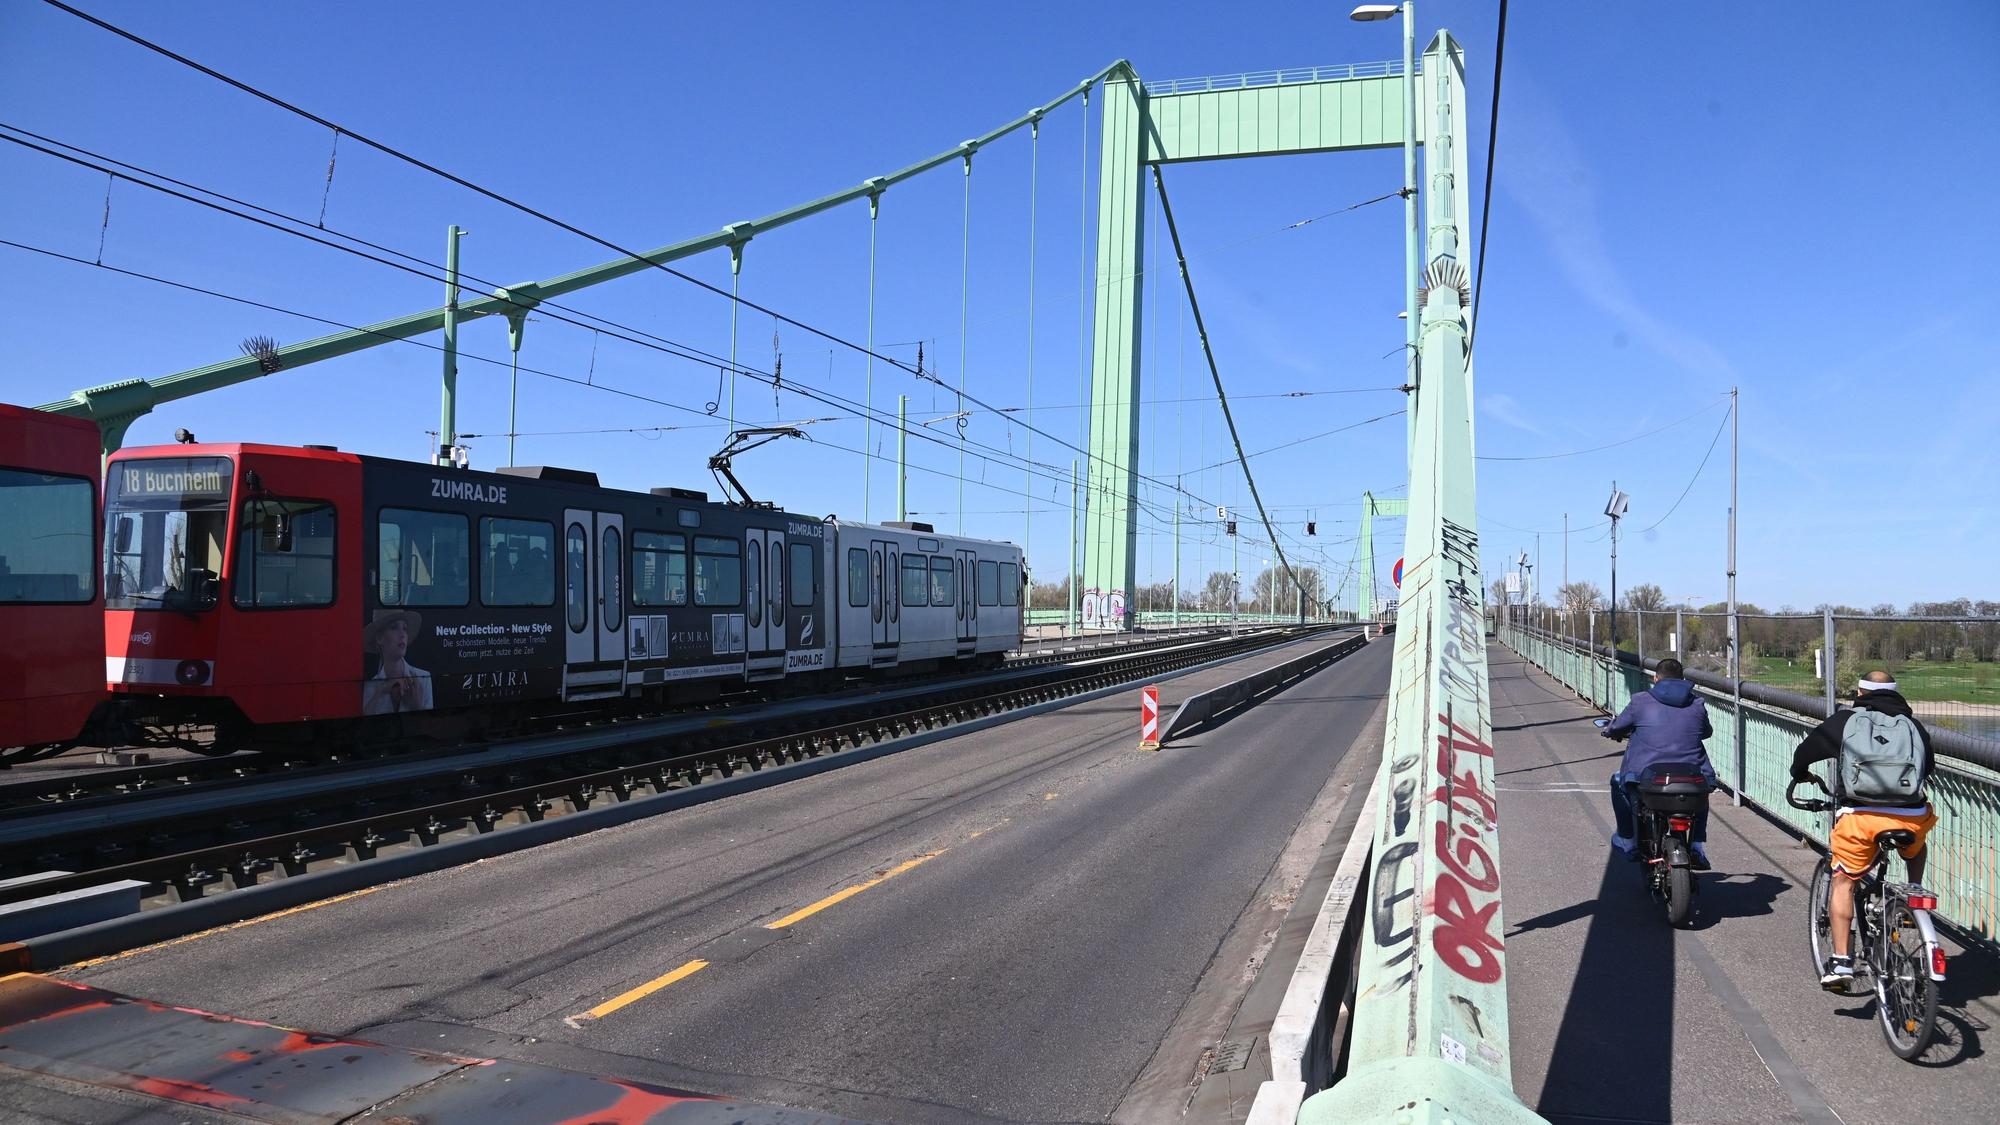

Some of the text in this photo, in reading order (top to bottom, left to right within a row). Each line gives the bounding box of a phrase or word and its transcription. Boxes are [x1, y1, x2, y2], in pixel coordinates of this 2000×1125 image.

[125, 470, 139, 492] 18
[432, 479, 507, 504] ZUMRA.DE
[1218, 507, 1225, 518] E
[788, 522, 823, 538] ZUMRA.DE
[436, 625, 457, 636] New
[460, 623, 504, 635] Collection
[512, 624, 530, 633] New
[532, 623, 552, 635] Style
[443, 638, 454, 648] Die
[513, 637, 527, 645] neue
[529, 635, 547, 644] Trends
[459, 649, 478, 658] Komm
[496, 648, 512, 656] nutze
[513, 647, 522, 655] die
[788, 653, 823, 668] ZUMRA.DE
